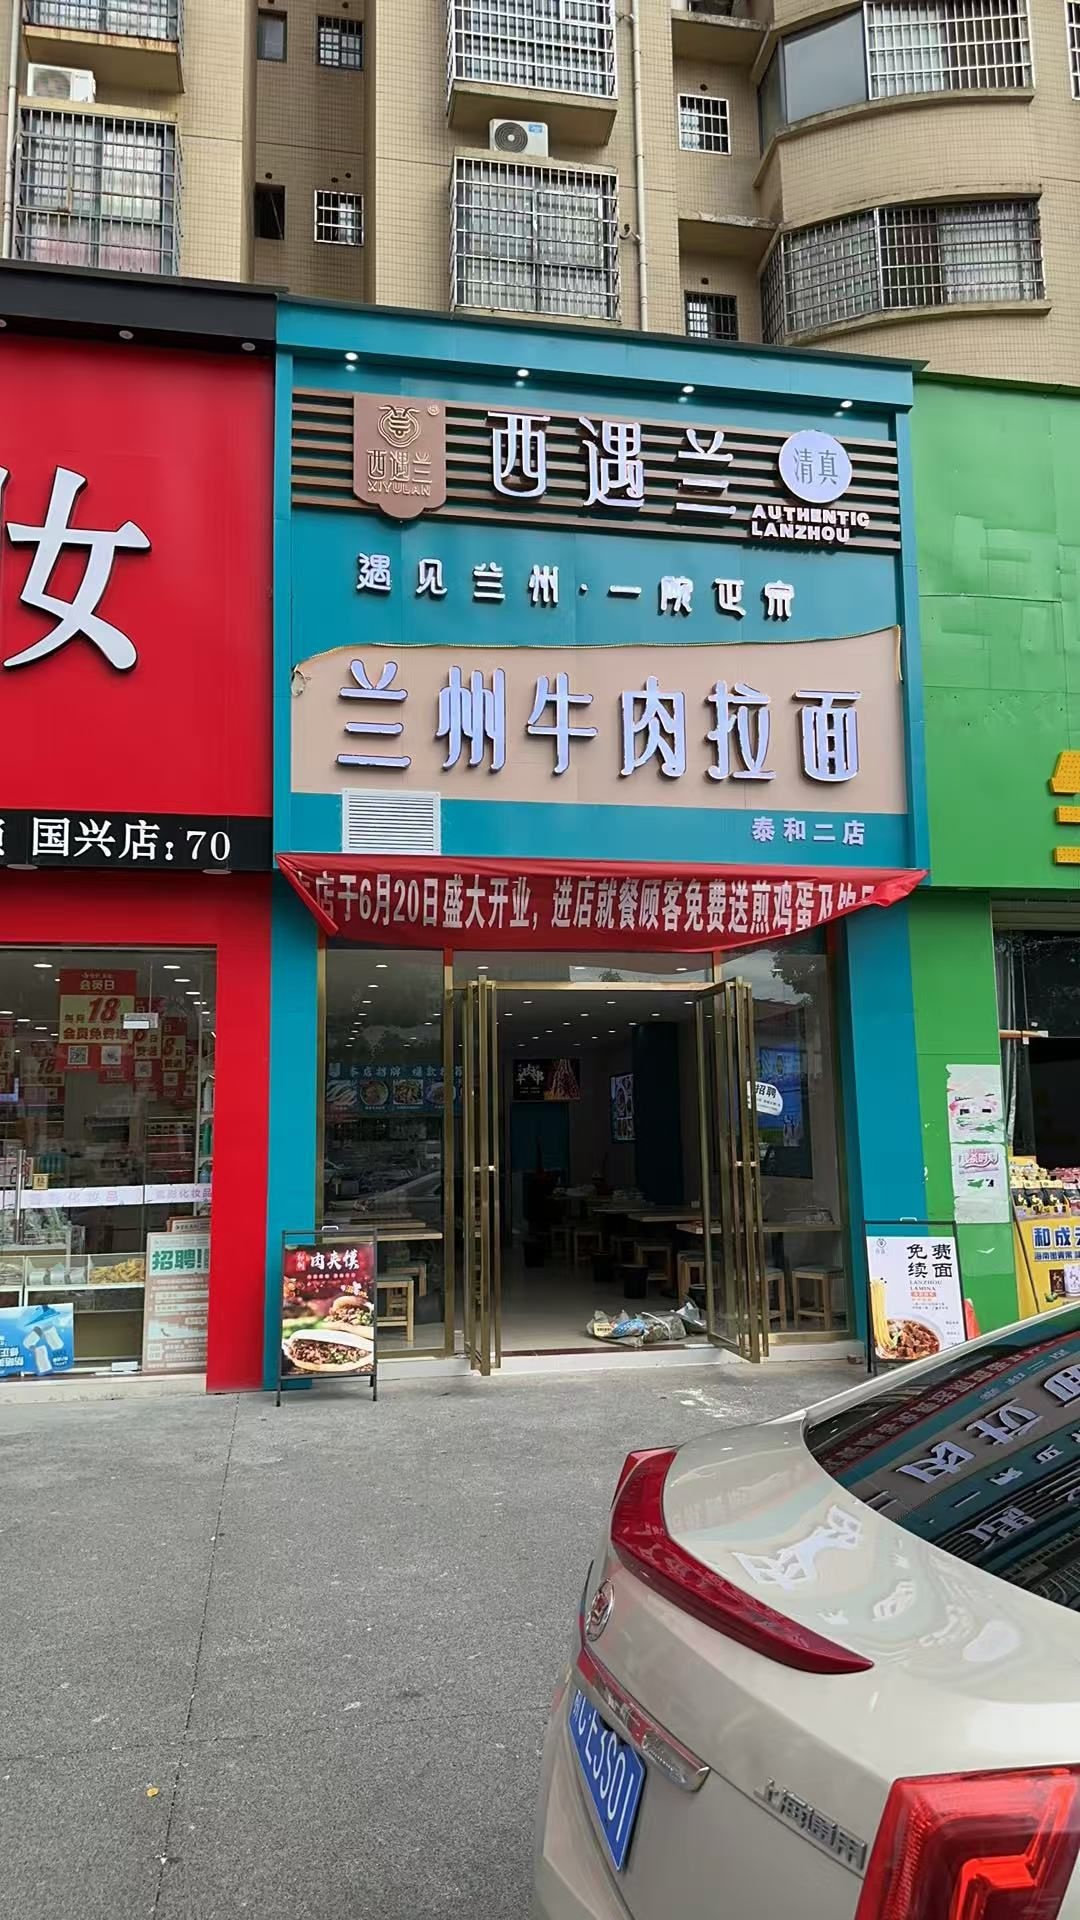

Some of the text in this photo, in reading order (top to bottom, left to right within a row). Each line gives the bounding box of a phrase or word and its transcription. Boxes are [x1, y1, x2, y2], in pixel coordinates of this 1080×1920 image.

[367, 449, 433, 484] 西遇兰
[487, 410, 737, 515] 西遇兰
[794, 448, 838, 485] 清真
[367, 480, 432, 497] XIYULAN
[751, 504, 870, 527] AUTHENTIC
[751, 520, 850, 542] LANZHOU
[0, 466, 151, 670] 女
[335, 658, 864, 784] 兰州牛肉拉面
[752, 816, 865, 845] 泰和二店
[80, 980, 115, 991] 会员日
[88, 997, 121, 1023] 18
[755, 1084, 777, 1099] 招聘
[310, 1249, 359, 1270] 肉夹馍
[907, 1244, 951, 1260] 免费
[907, 1262, 953, 1278] 续面
